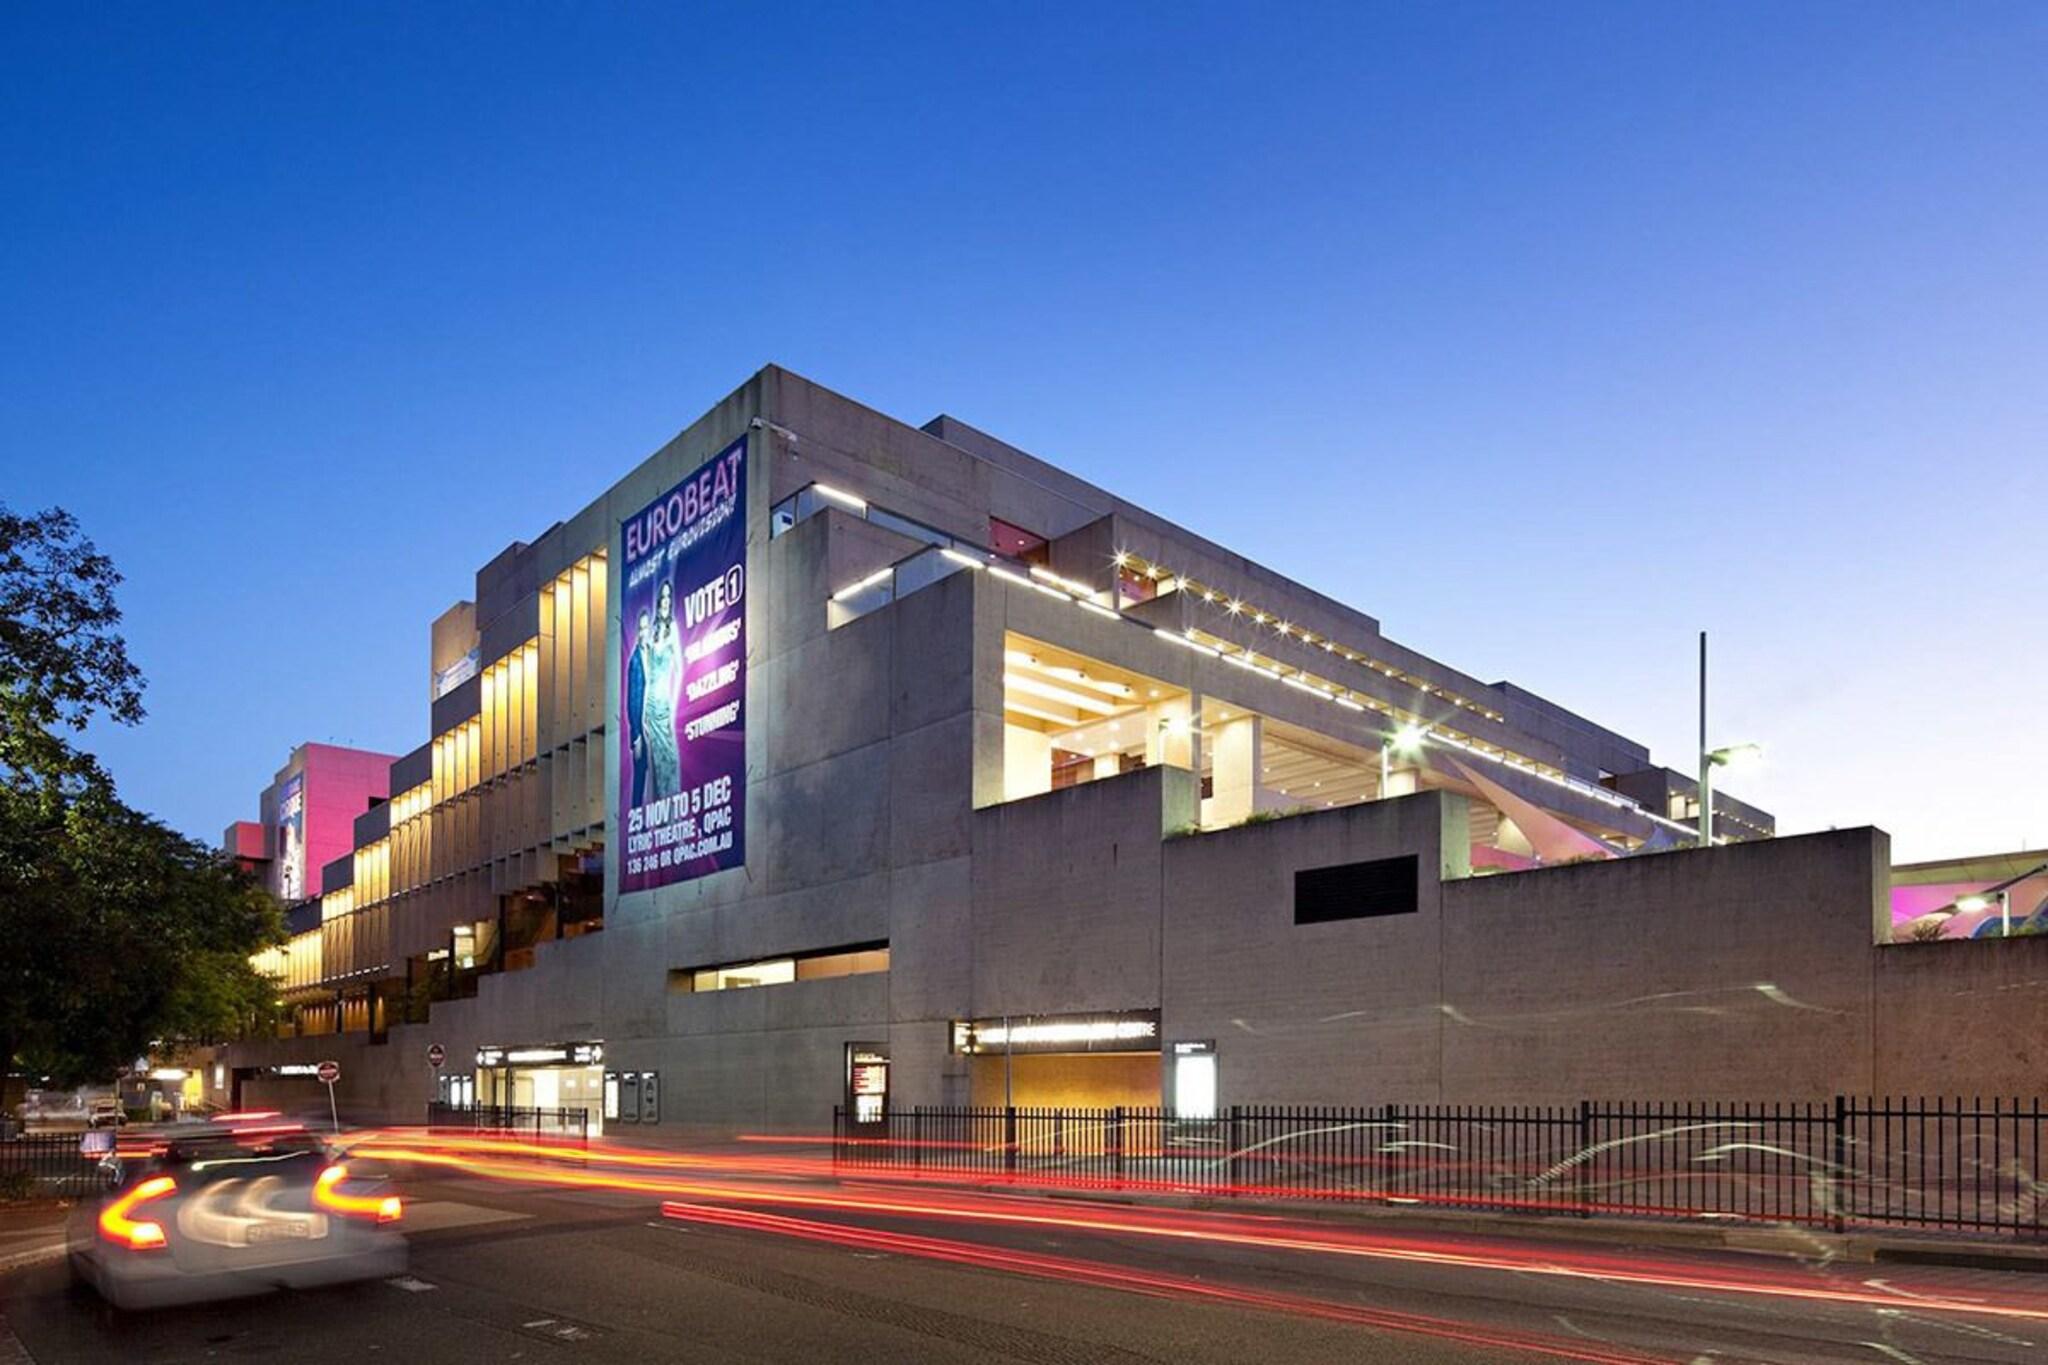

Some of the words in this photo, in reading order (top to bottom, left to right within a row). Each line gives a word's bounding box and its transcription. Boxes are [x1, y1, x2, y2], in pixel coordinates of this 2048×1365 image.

[626, 447, 743, 563] EUROBEAT
[629, 548, 666, 588] ALMOST
[684, 575, 725, 629] VOTE
[628, 807, 642, 834] 25
[645, 797, 671, 828] NOV
[672, 791, 689, 820] TO
[691, 787, 701, 814] 5
[703, 775, 732, 810] DEC
[628, 831, 653, 854] LYRIC
[703, 805, 732, 834] QPAC
